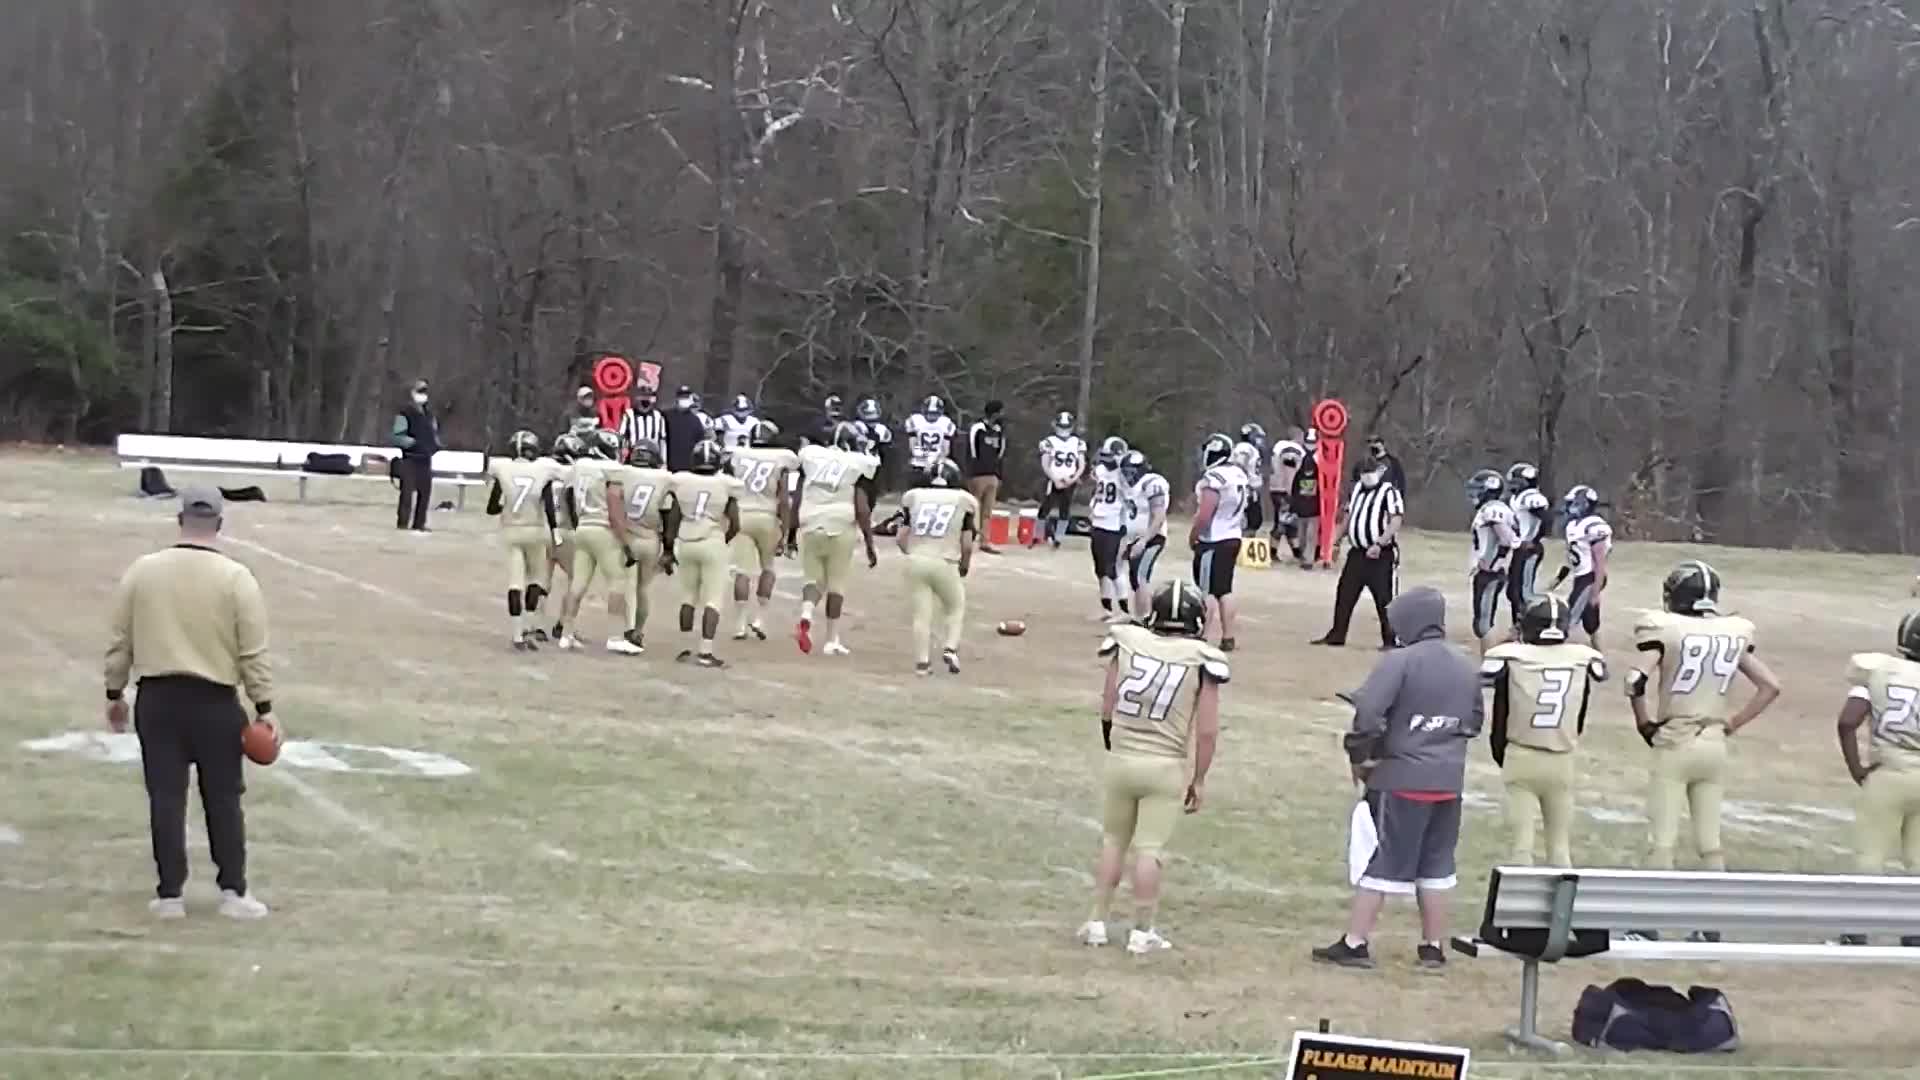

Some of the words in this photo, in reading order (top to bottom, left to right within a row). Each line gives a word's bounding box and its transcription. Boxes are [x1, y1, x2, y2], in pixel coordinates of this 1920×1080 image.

[737, 458, 775, 493] 78
[512, 476, 534, 513] 7
[626, 485, 655, 521] 9
[695, 491, 712, 515] 1
[1247, 541, 1268, 562] 40
[1670, 634, 1745, 695] 84
[1116, 652, 1189, 722] 21
[1531, 667, 1574, 729] 3
[1875, 685, 1920, 744] 2
[1302, 1048, 1368, 1071] PLEASE
[1369, 1055, 1457, 1079] MAINTAIN
